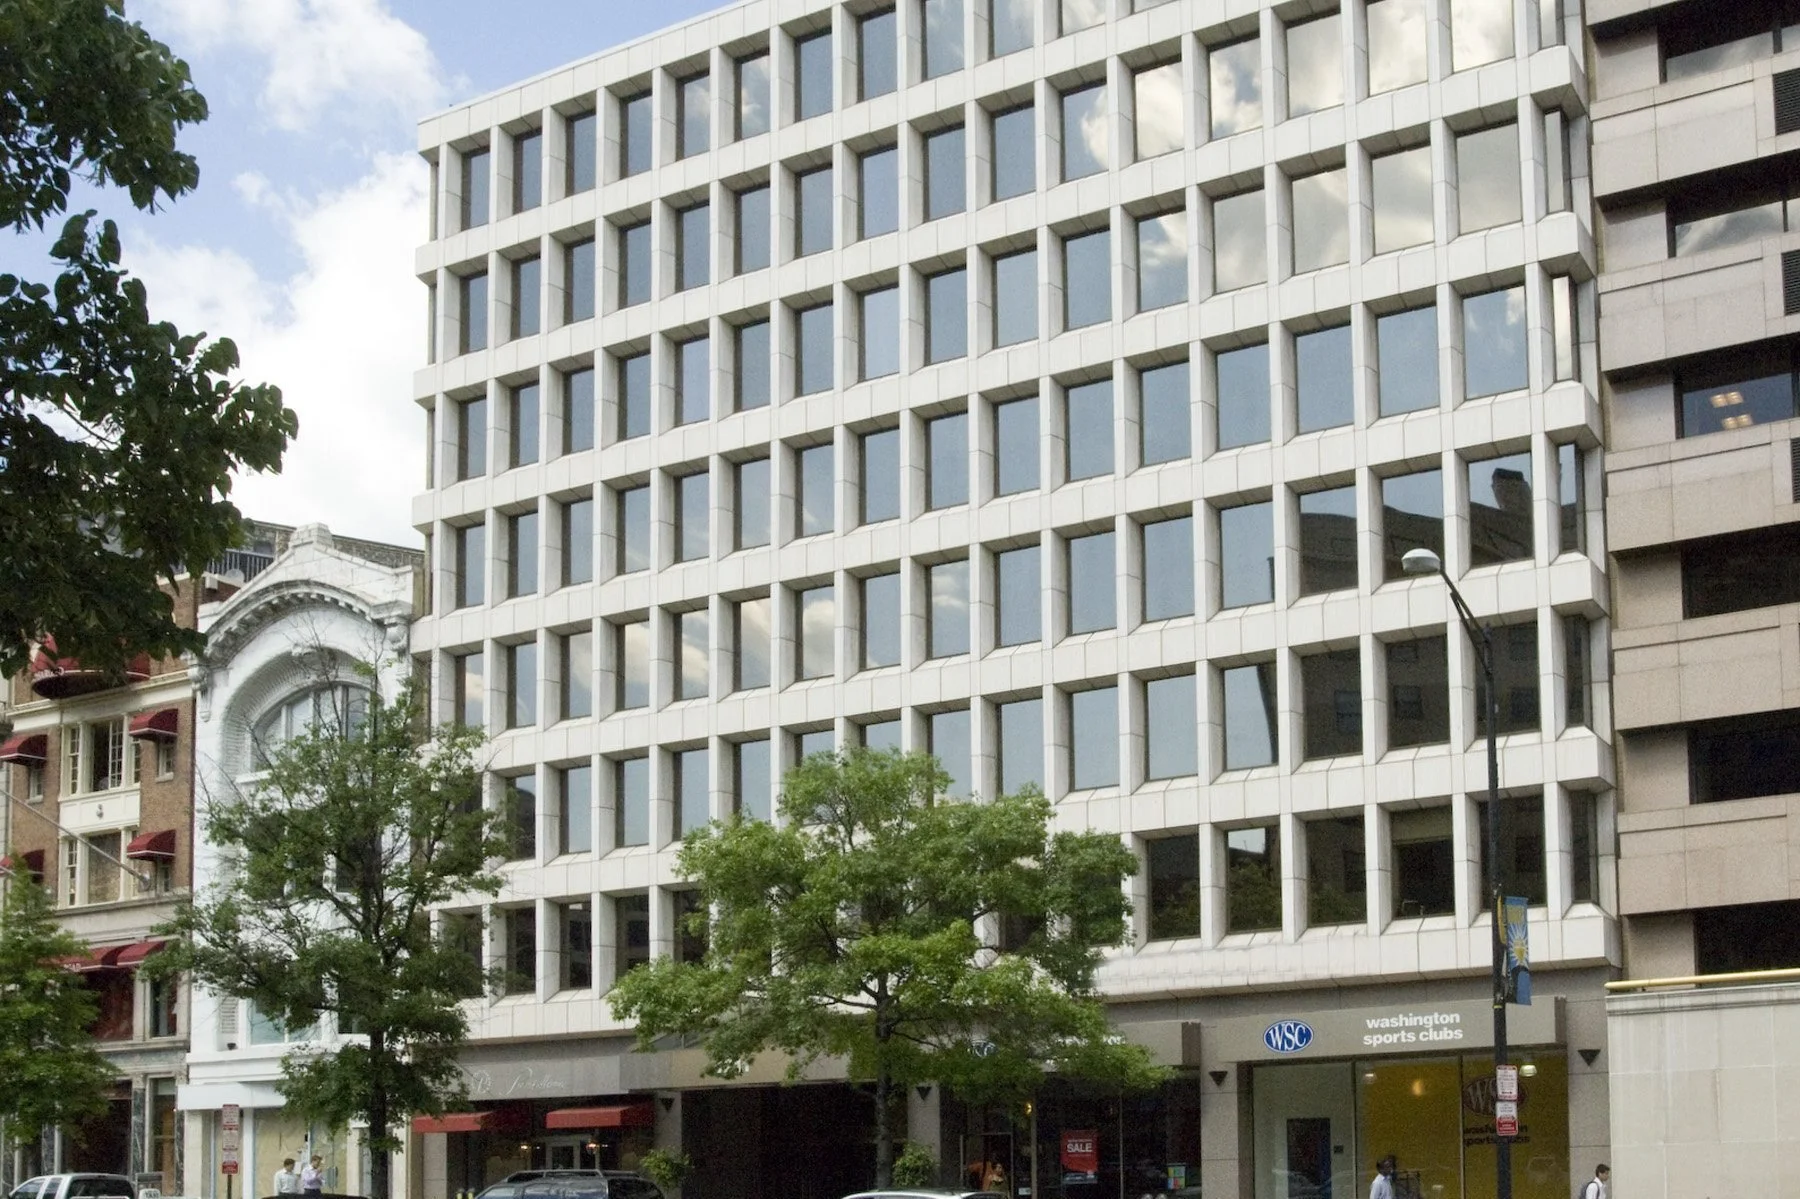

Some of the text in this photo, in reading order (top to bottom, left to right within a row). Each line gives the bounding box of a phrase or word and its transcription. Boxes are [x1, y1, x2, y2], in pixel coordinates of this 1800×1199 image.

[1366, 1012, 1460, 1029] washington
[1268, 1021, 1308, 1050] WSC
[1363, 1027, 1464, 1047] sports clubs
[1463, 1123, 1529, 1136] washn
[1067, 1143, 1092, 1152] SALE
